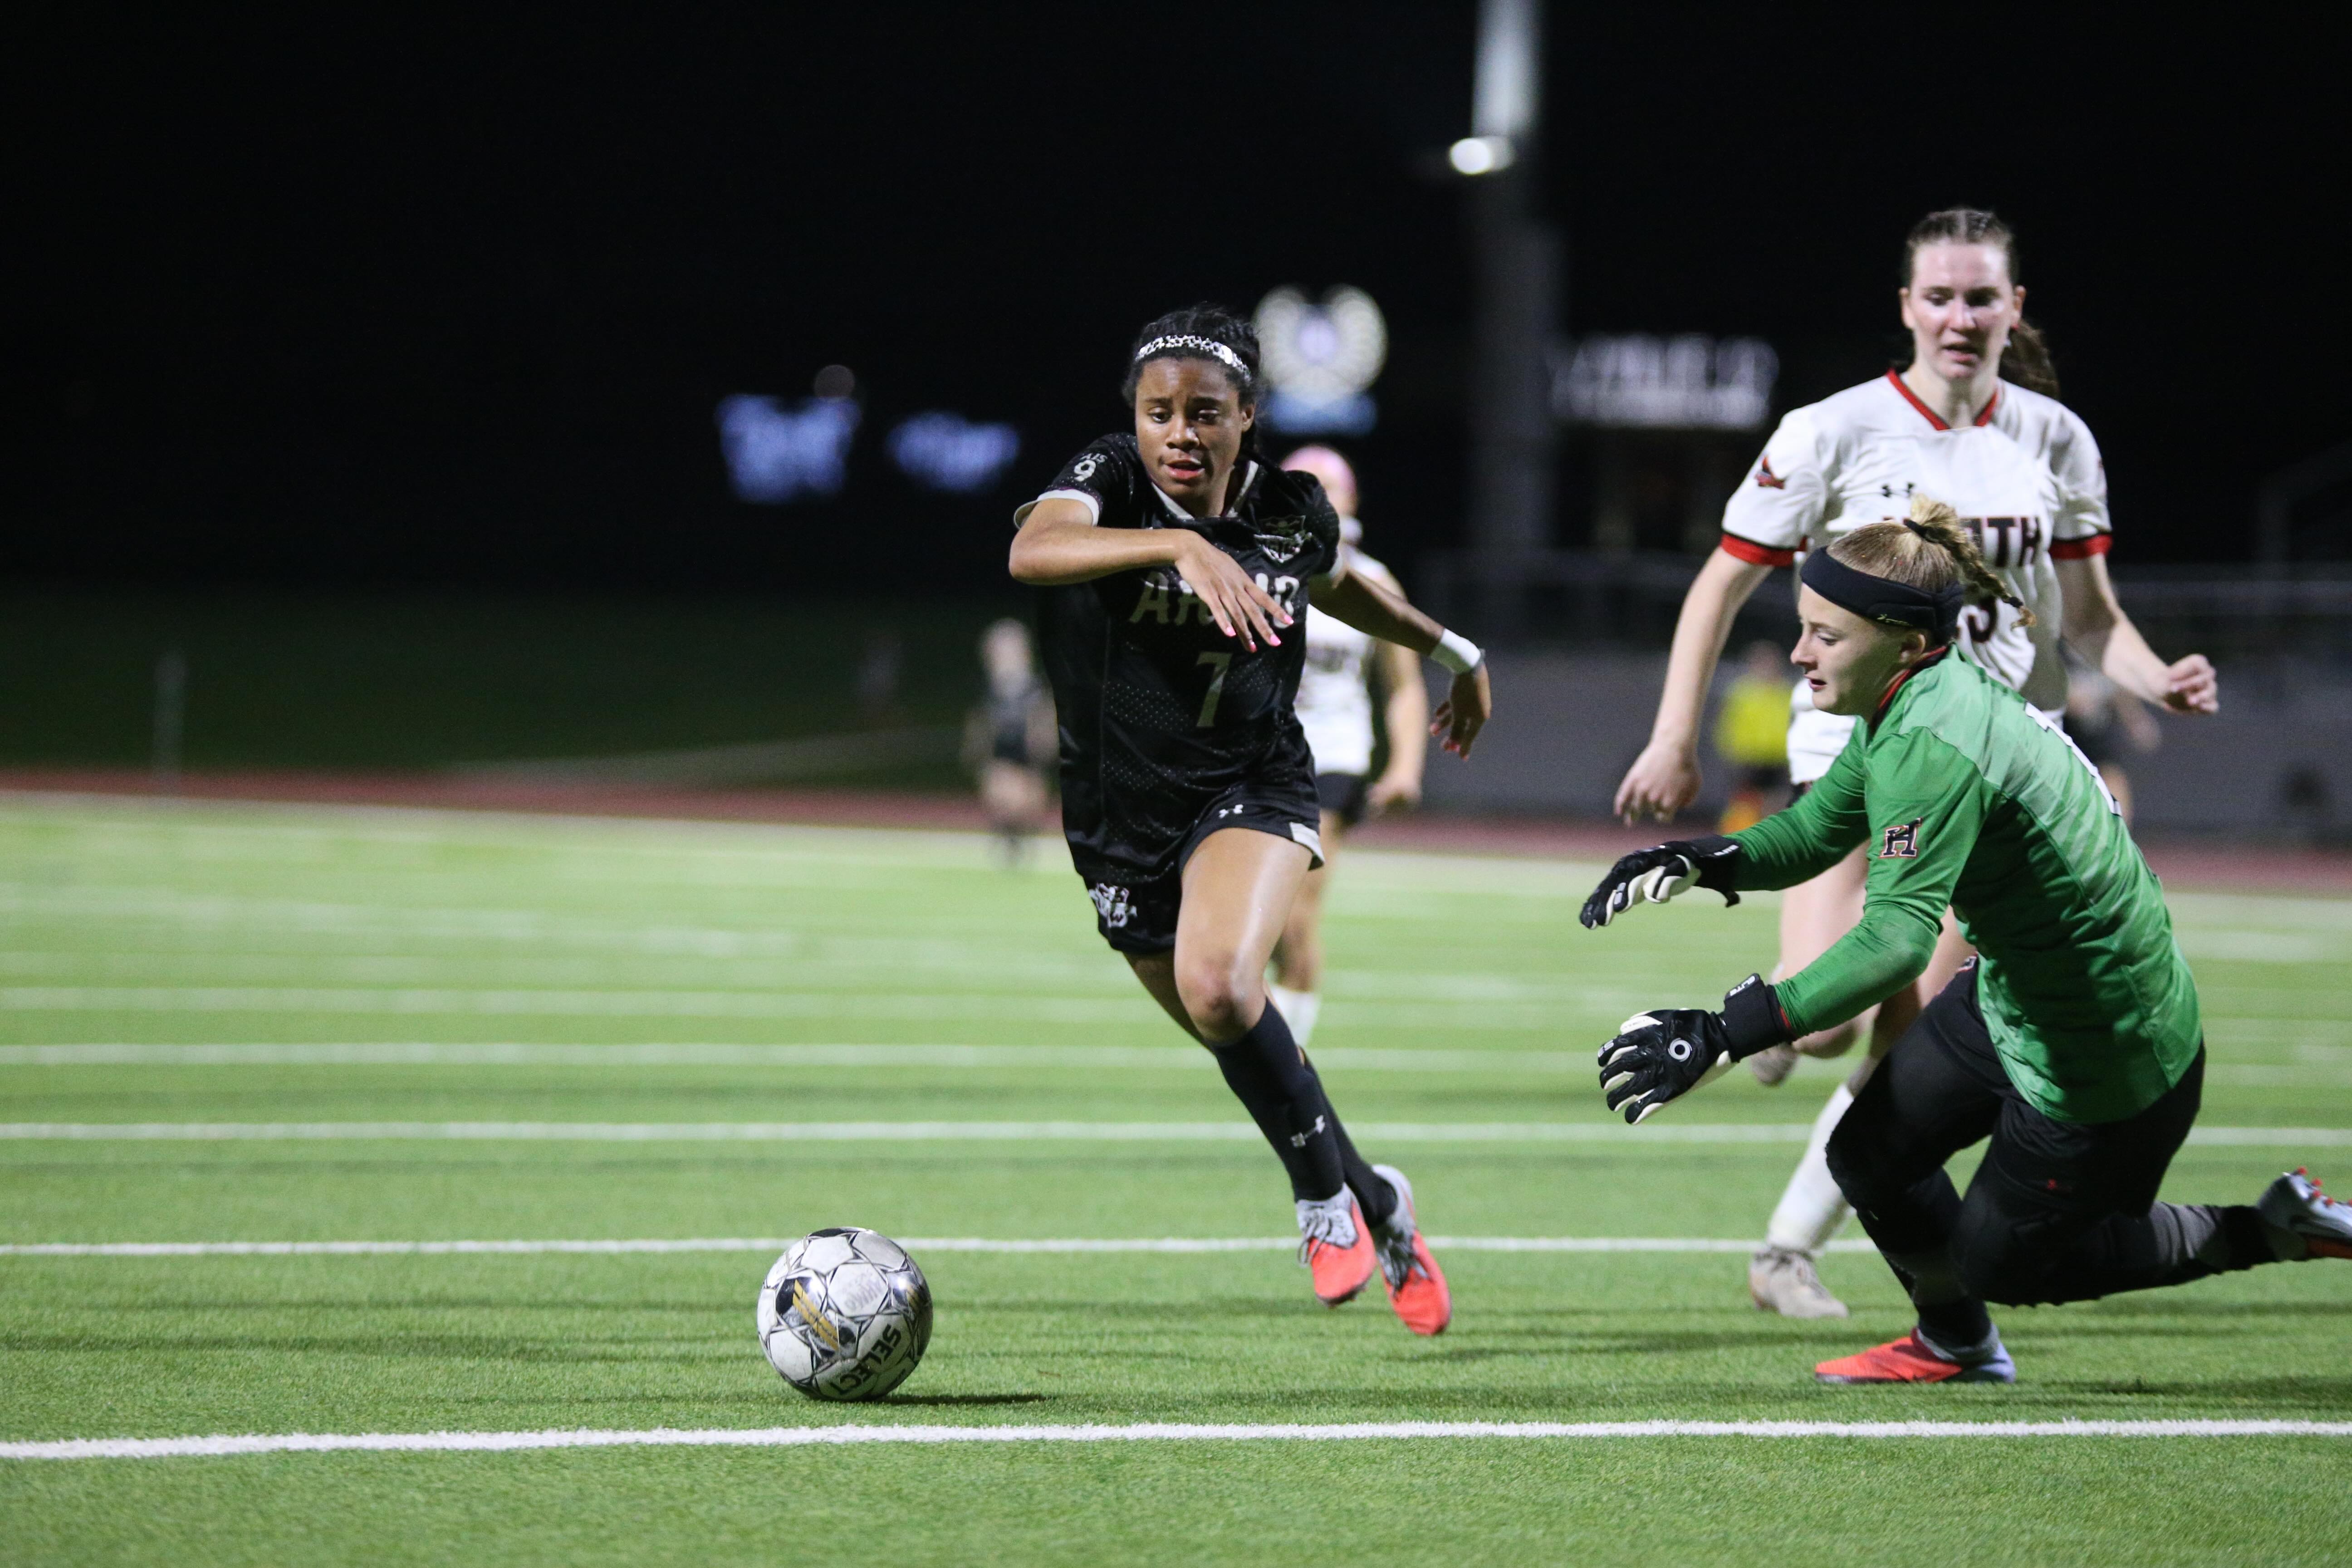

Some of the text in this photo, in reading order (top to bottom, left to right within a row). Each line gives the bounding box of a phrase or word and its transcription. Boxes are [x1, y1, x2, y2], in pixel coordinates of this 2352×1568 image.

[1073, 459, 1097, 482] 9
[1195, 652, 1233, 726] 7
[828, 1324, 902, 1395] SELECT
